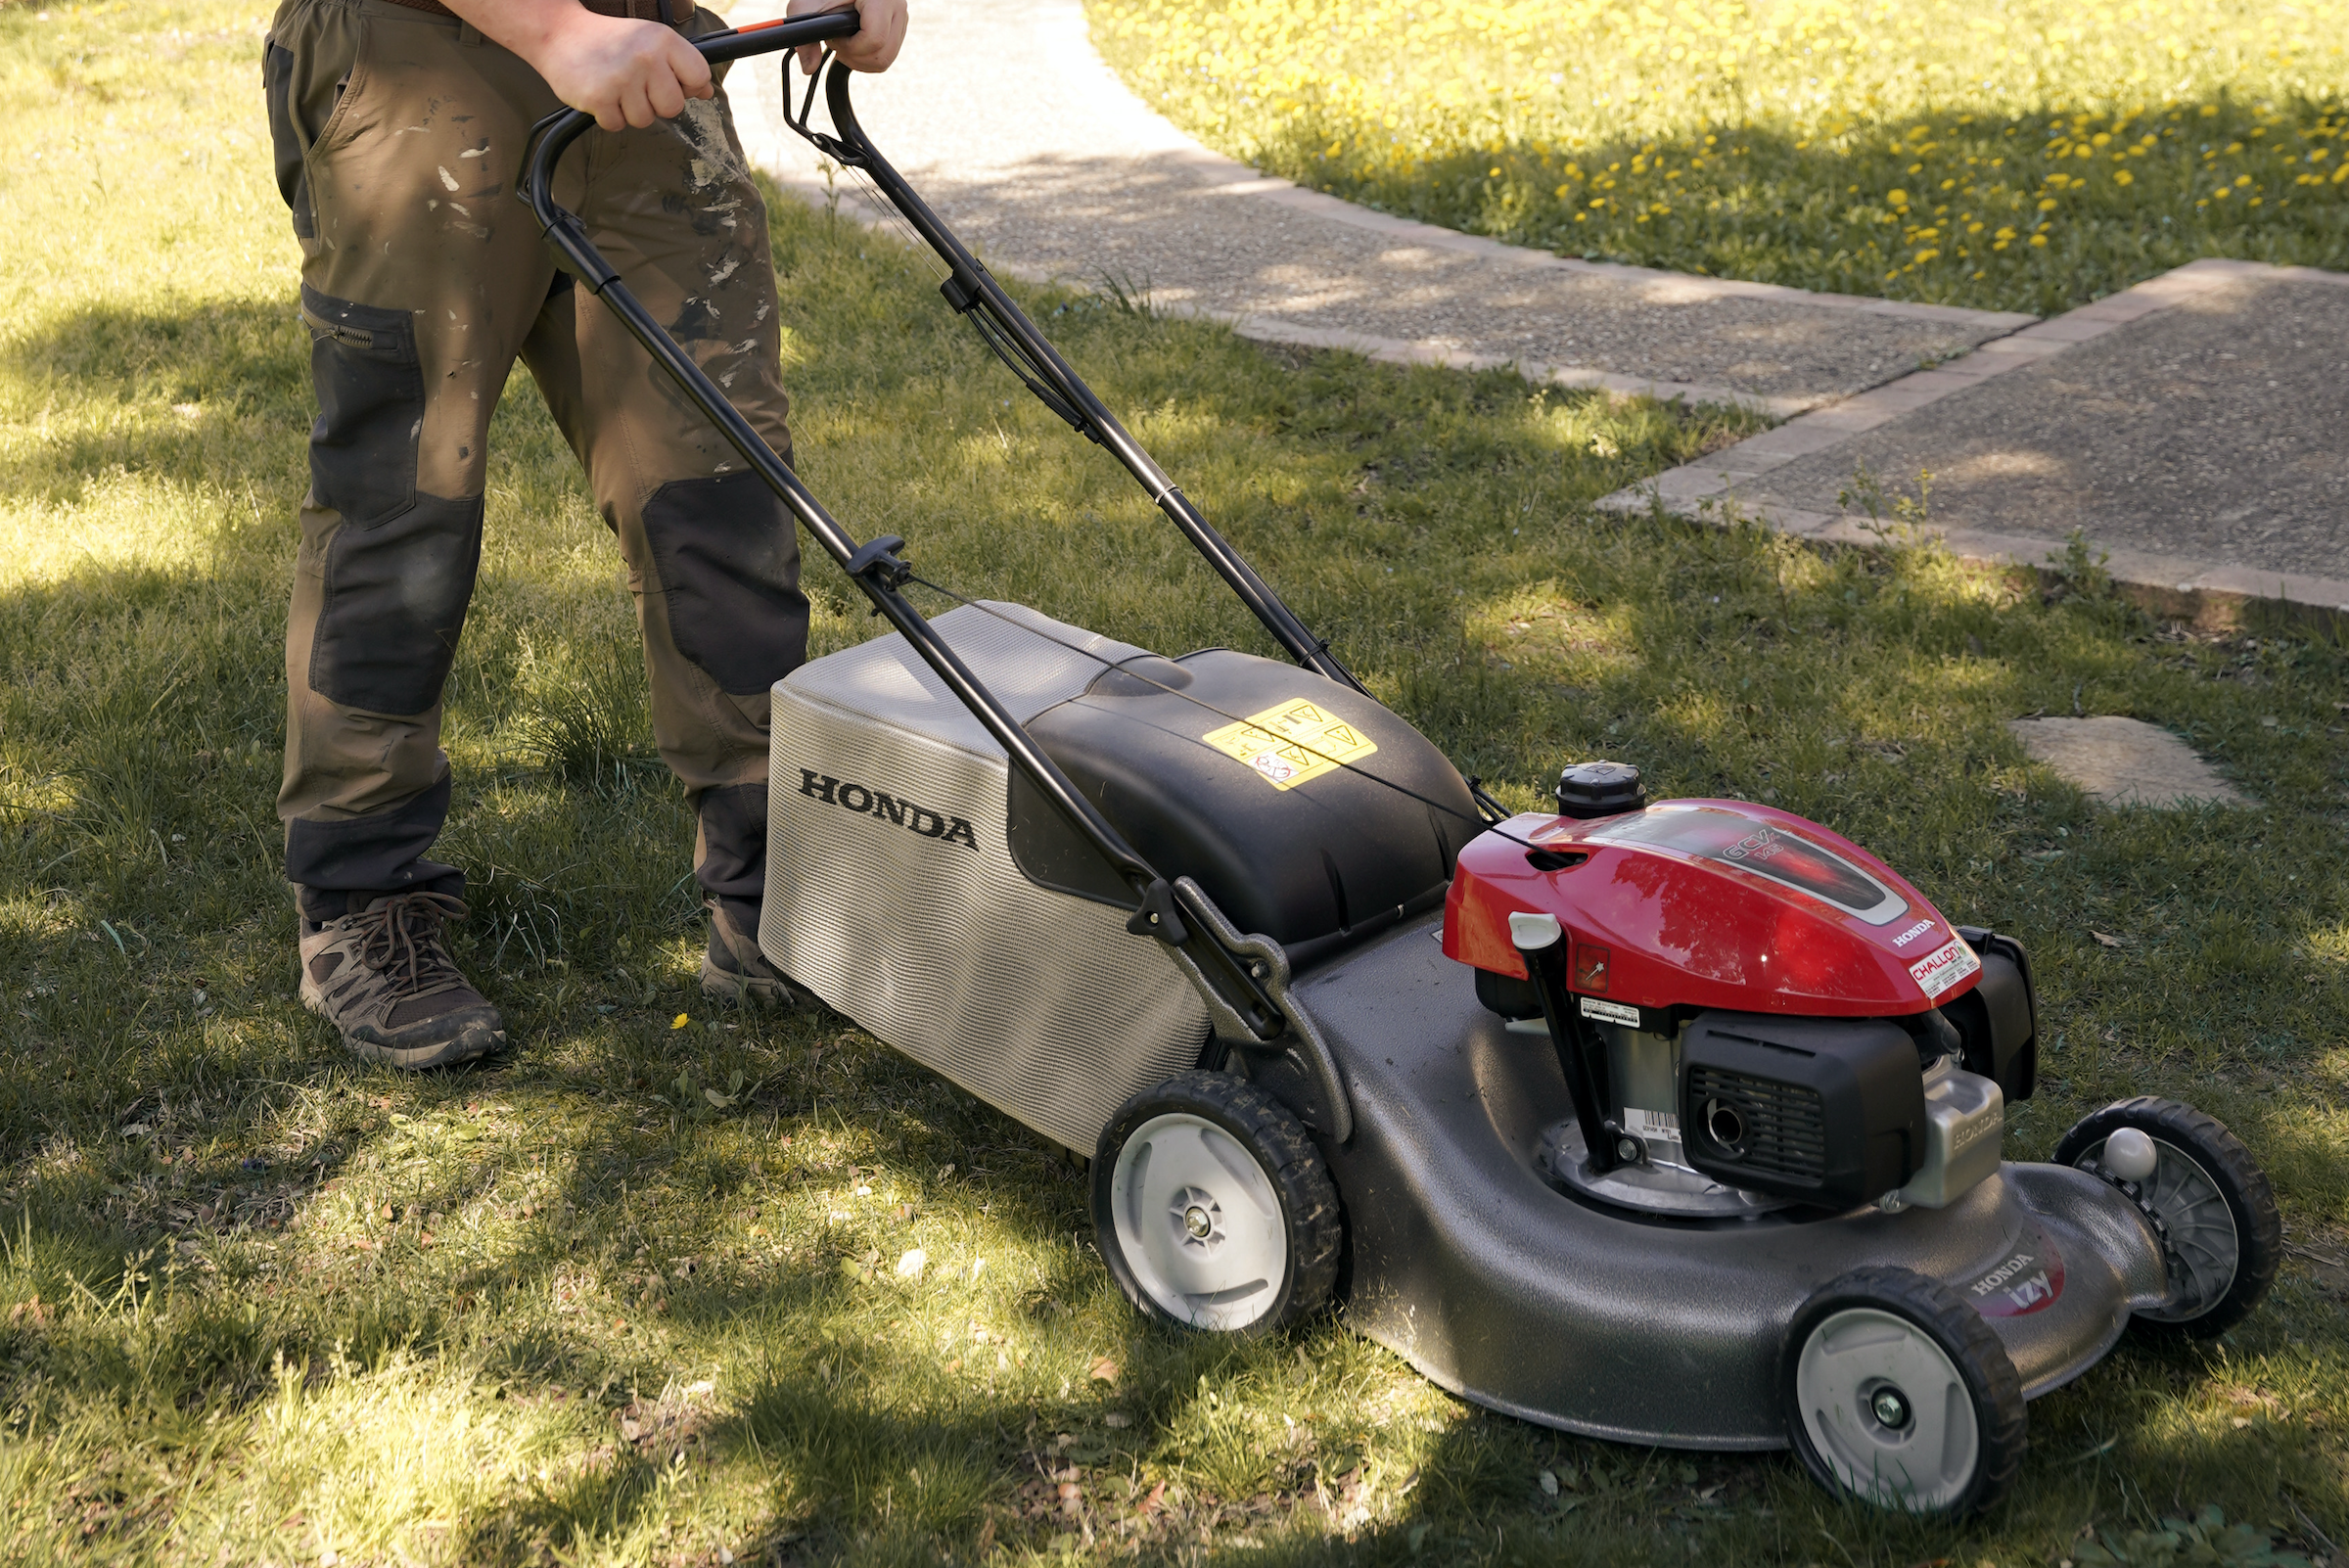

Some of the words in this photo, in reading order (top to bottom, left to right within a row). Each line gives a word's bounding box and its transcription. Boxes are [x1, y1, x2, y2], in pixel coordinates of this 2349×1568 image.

[798, 767, 980, 853] HONDA
[1754, 843, 1784, 860] 145
[1892, 918, 1936, 947] HONDA
[1954, 1112, 2004, 1150] HONDA
[1971, 1253, 2034, 1296] HONDA
